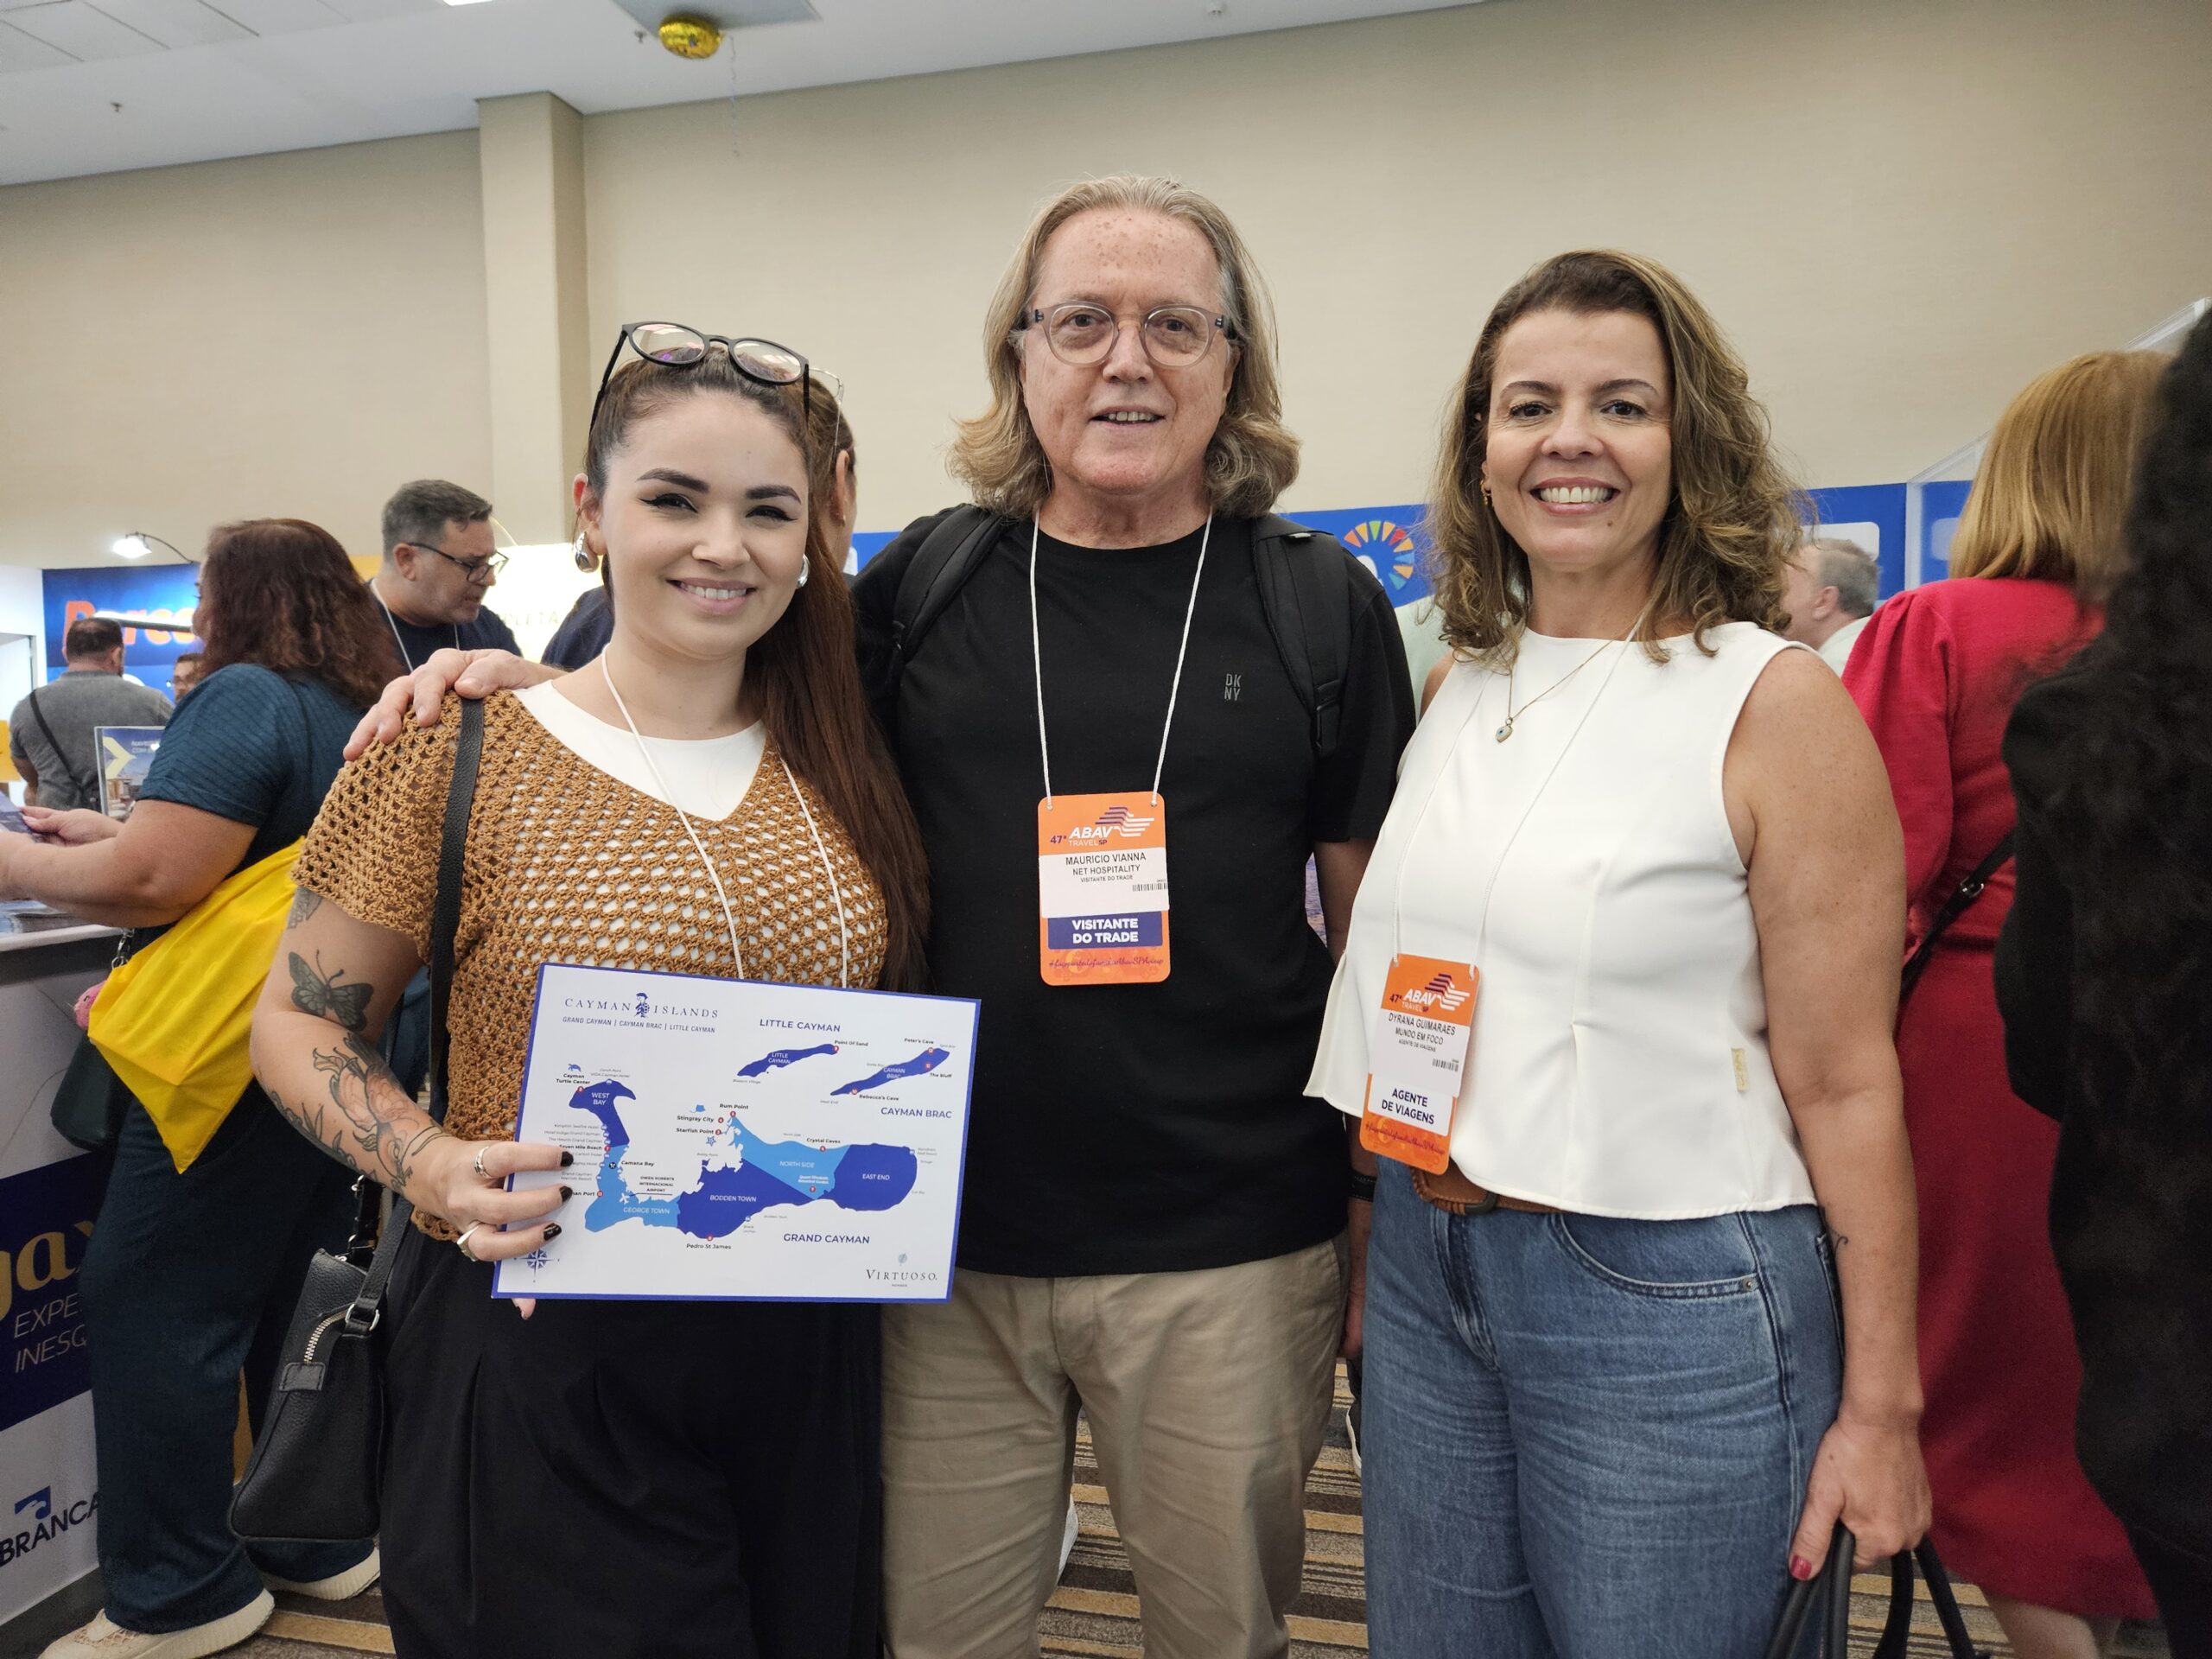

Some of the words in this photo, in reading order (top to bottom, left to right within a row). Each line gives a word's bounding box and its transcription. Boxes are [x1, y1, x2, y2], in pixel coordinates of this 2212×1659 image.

[1226, 673, 1242, 687] DK
[1224, 686, 1241, 701] NY
[1069, 826, 1114, 839] ABAV
[1065, 855, 1109, 866] MAURICIO
[1112, 852, 1147, 862] VIANNA
[1072, 868, 1088, 876] NET
[1090, 864, 1141, 874] HOSPITALITY
[1071, 918, 1139, 931] VISITANTE
[1072, 933, 1092, 944] DO
[1095, 931, 1139, 943] TRADE
[1403, 988, 1437, 1007] ABAV
[564, 998, 632, 1011] CAYMAN
[653, 1005, 719, 1018] ISLANDS
[619, 1020, 644, 1028] CAYMAN
[690, 1025, 715, 1033] CAYMAN
[760, 1019, 793, 1029] LITTLE
[797, 1021, 841, 1033] CAYMAN
[1389, 1013, 1414, 1027] DYRANA
[1415, 1019, 1456, 1036] GUIMARAES
[1395, 1027, 1416, 1039] MUNDO
[1416, 1032, 1426, 1040] EM
[1426, 1034, 1444, 1045] FOCO
[1392, 1088, 1428, 1108] AGENTE
[880, 1107, 923, 1118] CAYMAN
[925, 1109, 952, 1119] BRAC
[1382, 1099, 1394, 1112] DE
[1395, 1103, 1435, 1125] VIAGENS
[783, 1233, 822, 1243] GRAND
[825, 1235, 870, 1244] CAYMAN
